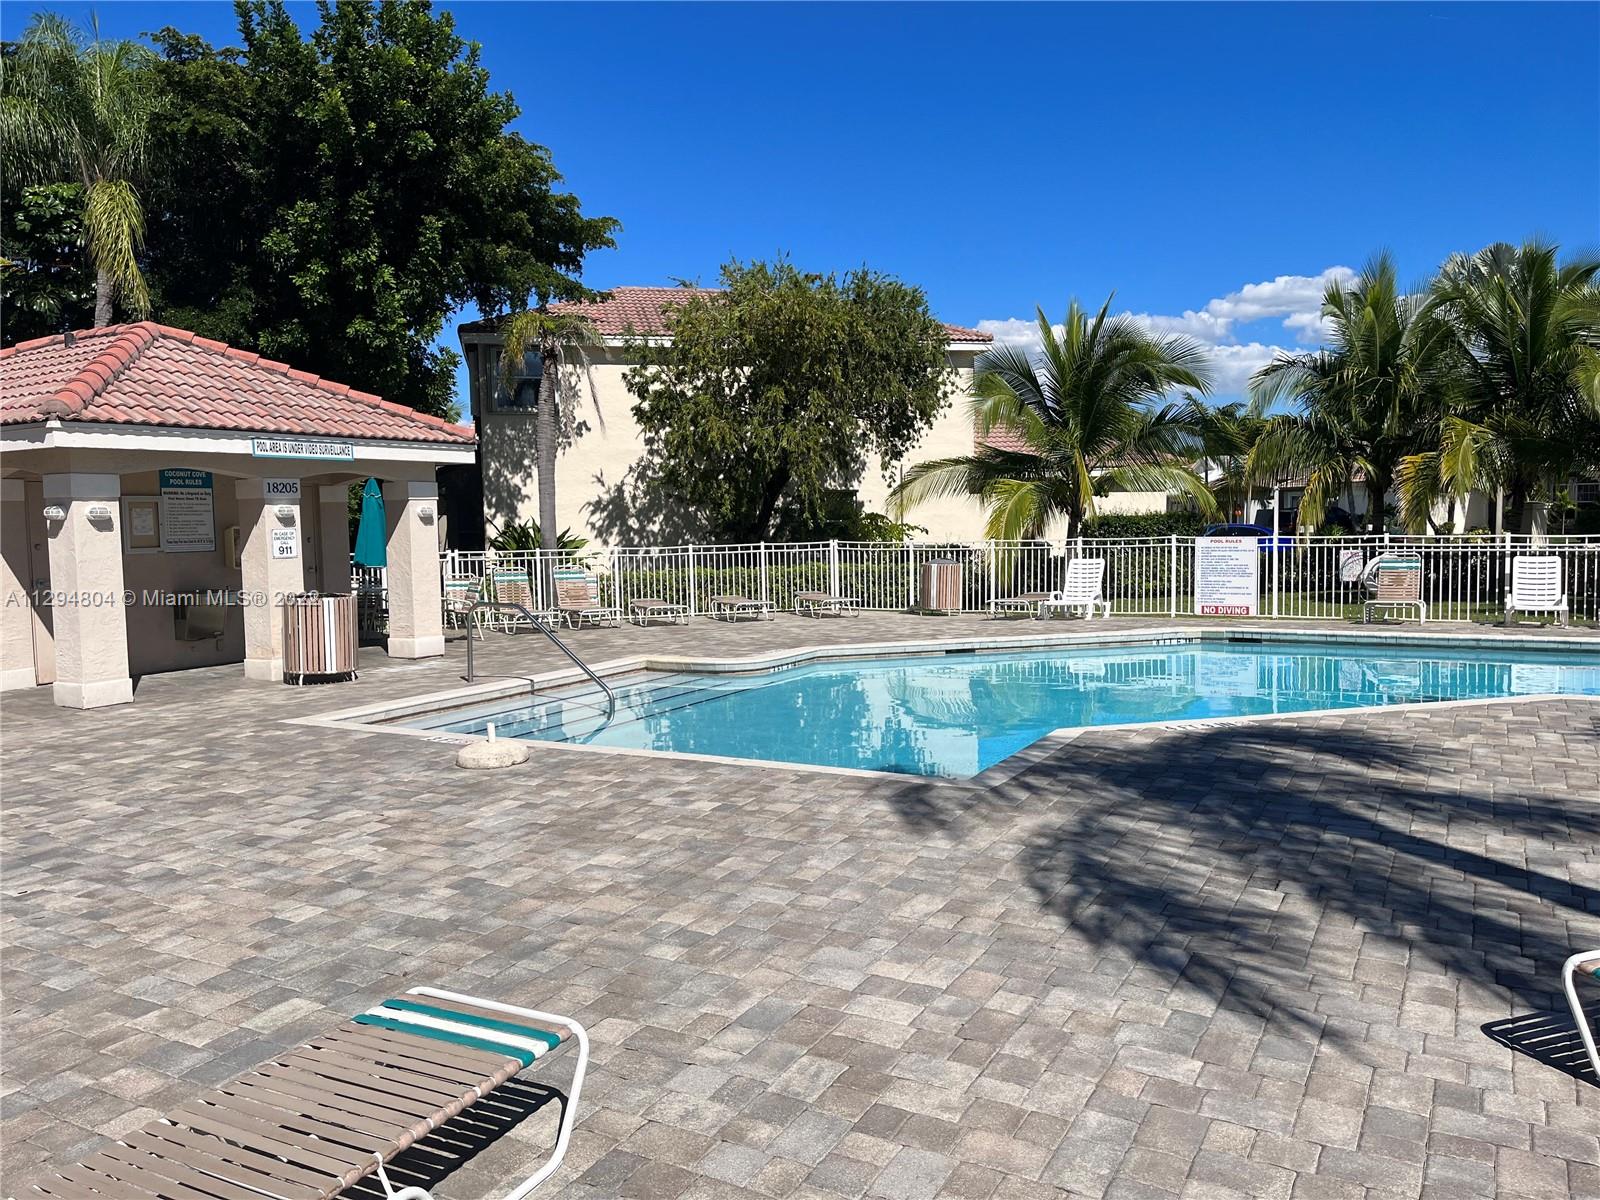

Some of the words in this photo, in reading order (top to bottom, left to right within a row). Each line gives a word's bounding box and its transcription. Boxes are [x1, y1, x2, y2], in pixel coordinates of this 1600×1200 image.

[256, 441, 268, 452] POOL
[269, 442, 281, 453] AREA
[282, 442, 287, 453] IS
[288, 443, 304, 454] UNDER
[304, 444, 318, 455] VIDEO
[319, 444, 350, 456] SURVEILLANCE
[266, 482, 298, 494] 18205
[278, 545, 293, 555] 911
[1203, 606, 1216, 614] NO
[1217, 606, 1248, 615] DIVING
